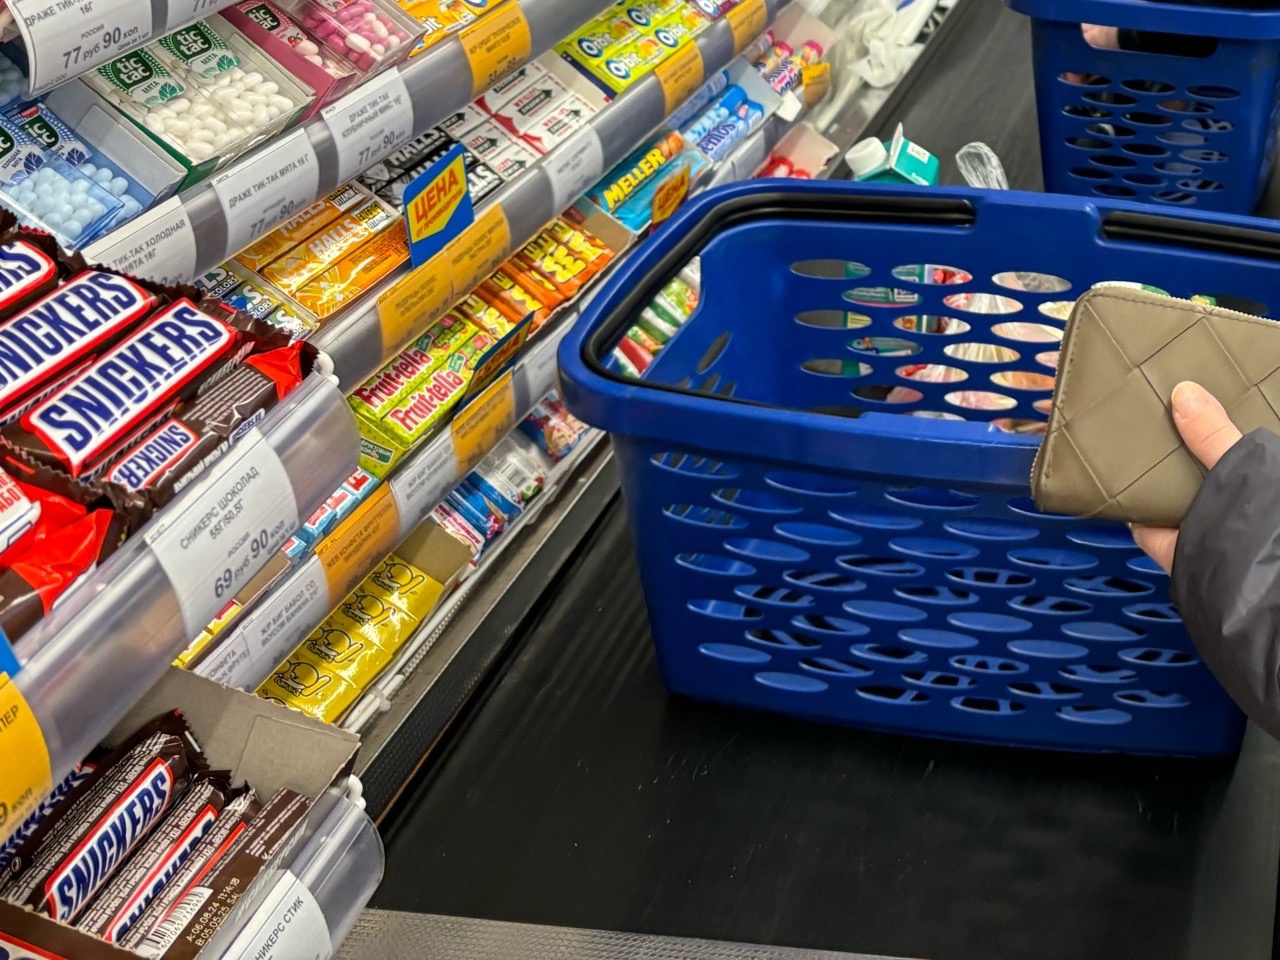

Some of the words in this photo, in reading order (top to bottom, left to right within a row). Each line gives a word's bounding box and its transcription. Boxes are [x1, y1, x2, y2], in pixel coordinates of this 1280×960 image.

[24, 6, 56, 28] ДРАЖЕ
[81, 24, 104, 39] РОССИЯ
[63, 46, 82, 69] 77
[83, 44, 100, 60] руб
[103, 27, 121, 49] 90
[123, 26, 138, 39] коп
[176, 30, 201, 45] tic
[180, 39, 209, 55] tac
[657, 24, 689, 45] Orbit
[116, 57, 142, 73] tic
[119, 66, 150, 84] tac
[608, 51, 643, 76] Orbit
[359, 146, 371, 165] 77
[384, 131, 394, 149] 90
[229, 188, 253, 209] ДРАЖЕ
[253, 171, 279, 193] ТИК-ТАК
[279, 162, 297, 177] МЯТА
[603, 148, 667, 209] MELLER
[414, 168, 459, 224] ЦЕНА
[113, 245, 144, 268] ТИК-ТАК
[145, 219, 186, 248] ХОЛОДНАЯ
[308, 218, 360, 258] HALLS
[212, 276, 237, 297] COLORS
[250, 299, 273, 319] OLORS
[0, 271, 142, 393] NICKERS
[37, 305, 223, 453] SNICKERS
[180, 506, 219, 550] СНИКЕРС
[218, 466, 260, 510] ШОКОЛАД
[214, 567, 233, 598] 69
[235, 556, 250, 580] руб
[251, 528, 269, 559] 90
[270, 520, 285, 539] коп
[227, 532, 251, 558] РОССИЯ
[57, 770, 169, 921] SNICKERS
[283, 896, 304, 927] СТИК
